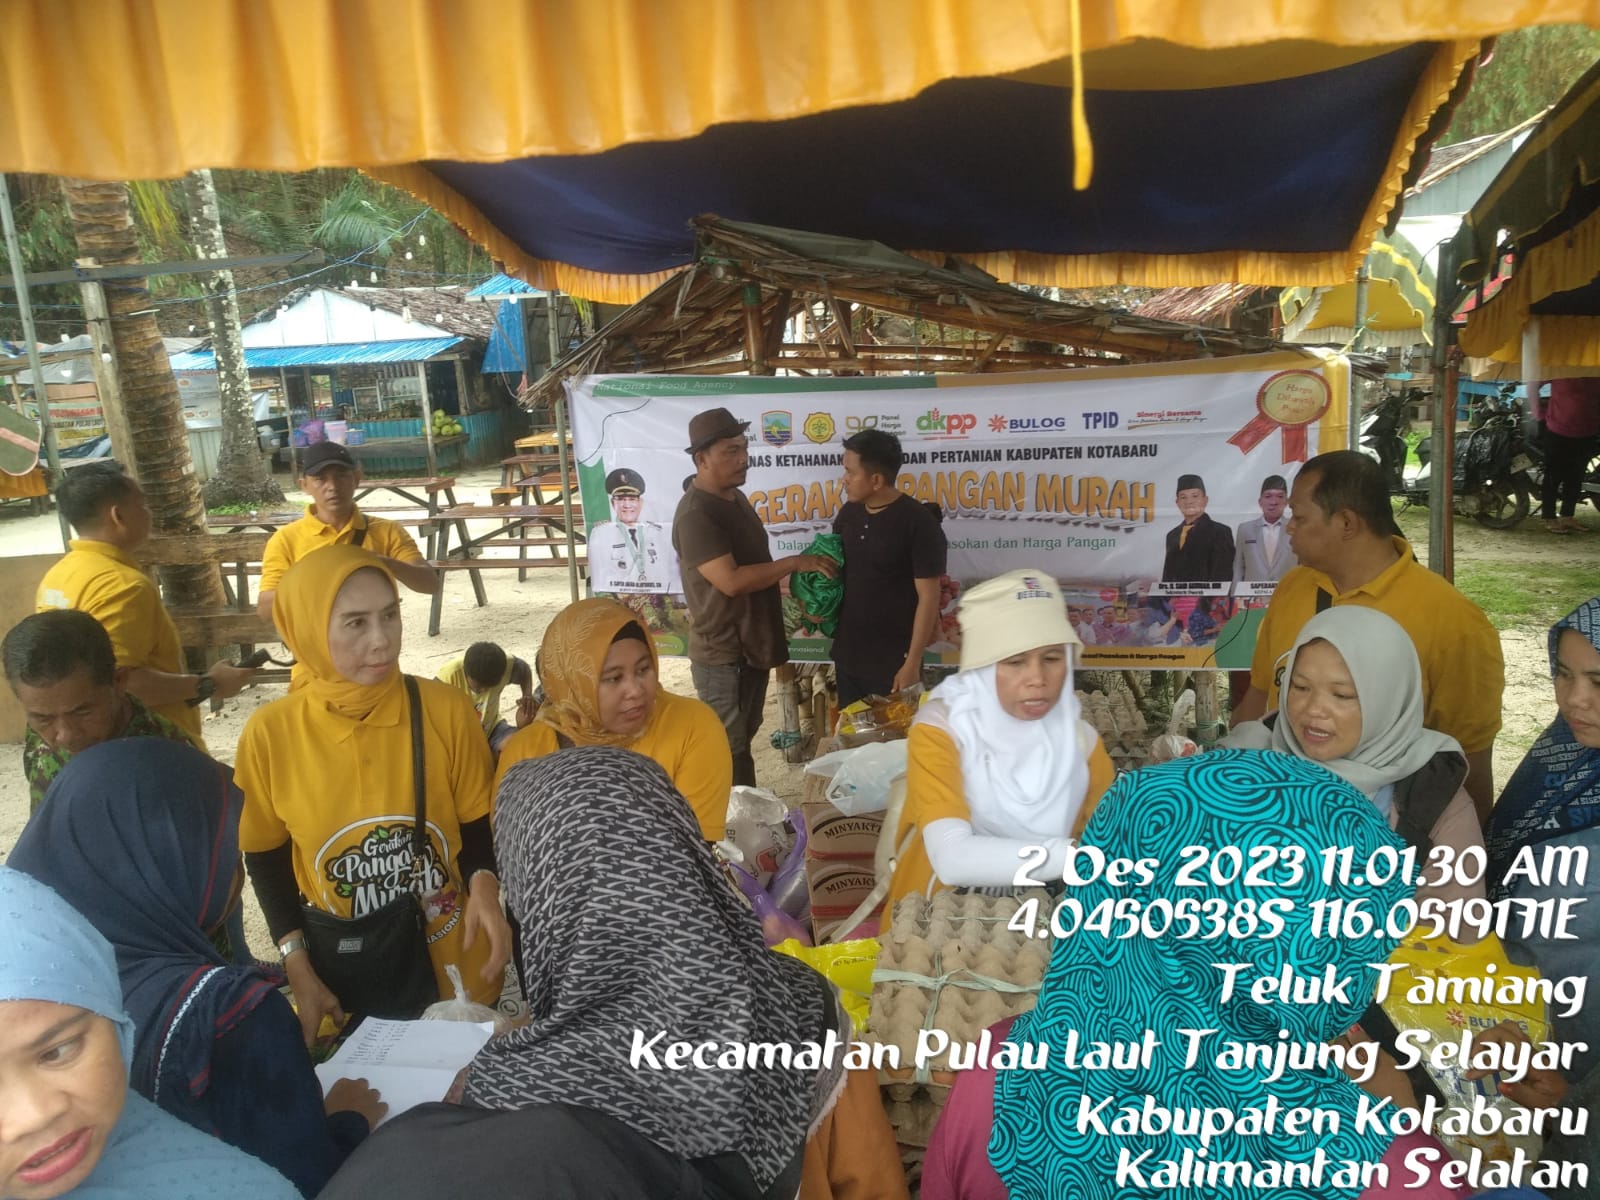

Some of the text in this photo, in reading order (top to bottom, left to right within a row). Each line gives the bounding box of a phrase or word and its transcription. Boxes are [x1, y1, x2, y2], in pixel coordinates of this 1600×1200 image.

[597, 380, 737, 391] National Food Agency
[916, 408, 977, 434] dkpp
[1009, 417, 1066, 429] BULOG
[1082, 411, 1119, 430] TPID
[748, 455, 772, 467] NAS
[902, 443, 1158, 465] DAN PERTANIAN KABUPATEN KOTABARU
[749, 478, 845, 525] GERAK
[896, 470, 1157, 523] PANGAN MURAH
[994, 537, 1018, 549] dan
[1023, 537, 1062, 551] Harga
[1066, 536, 1116, 551] Pangan
[1469, 1015, 1529, 1031] BULG
